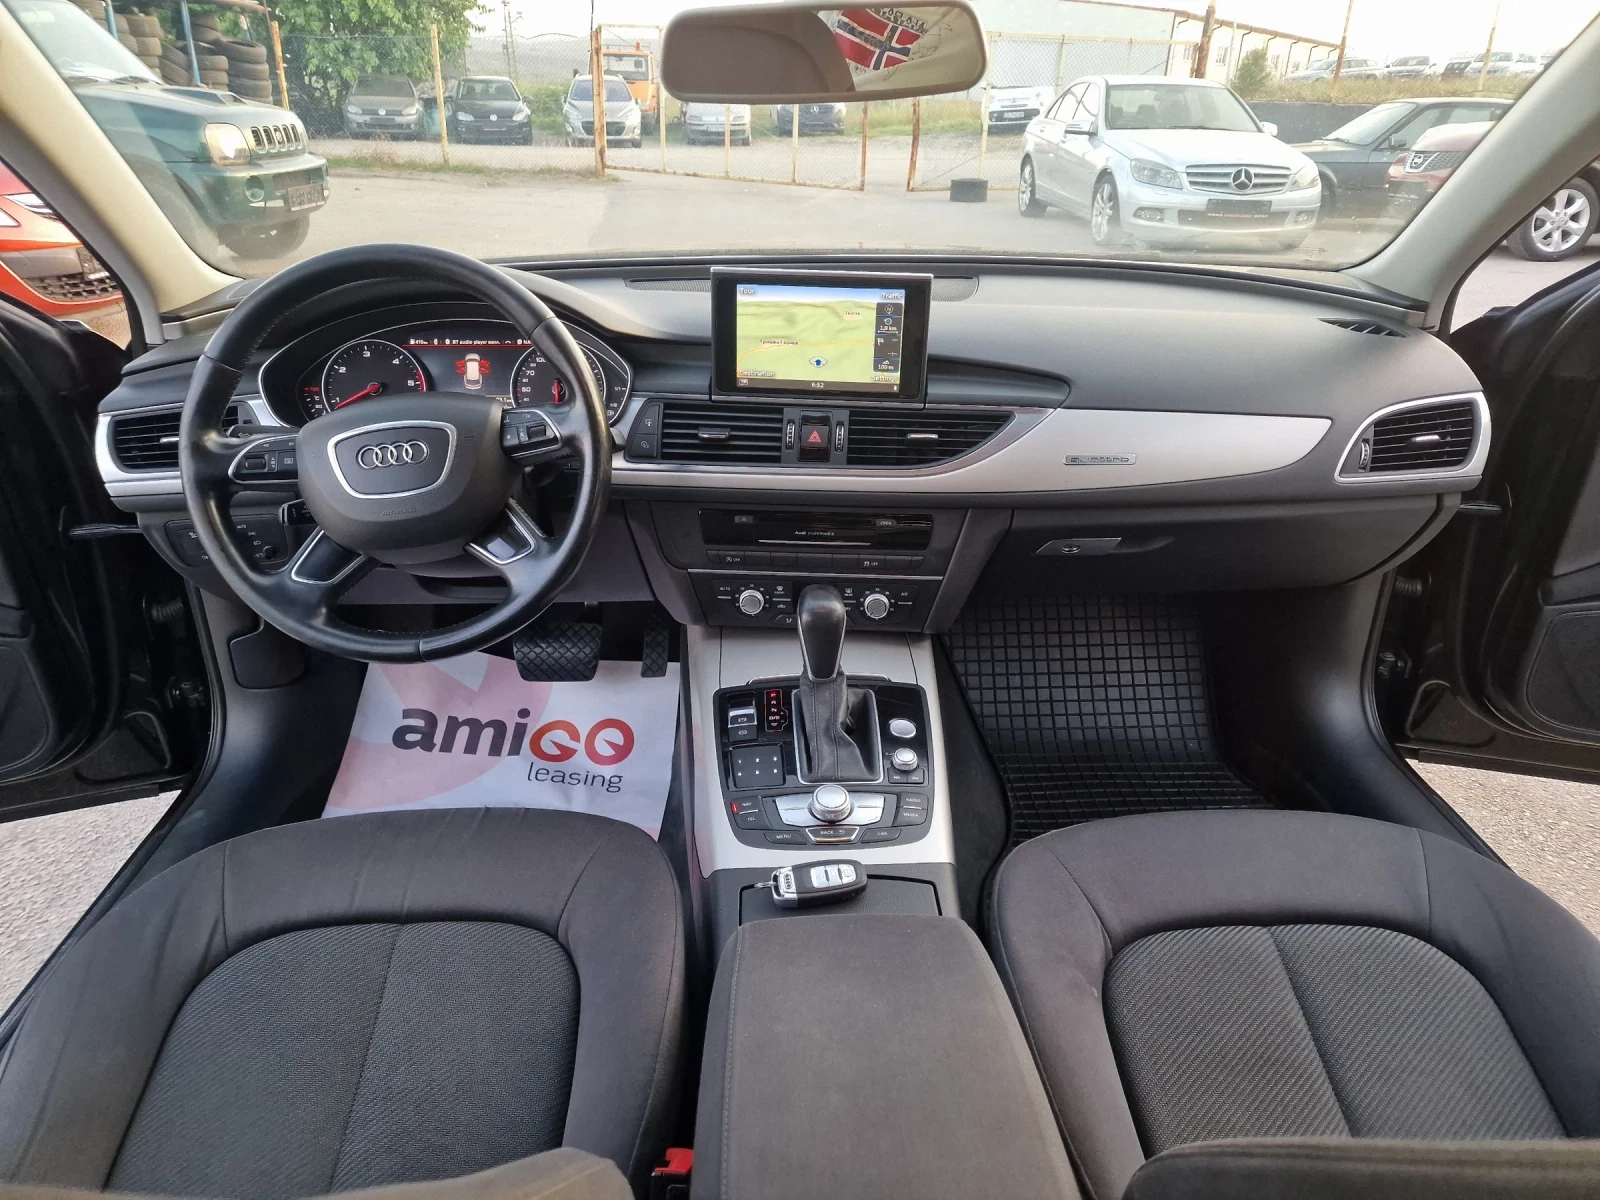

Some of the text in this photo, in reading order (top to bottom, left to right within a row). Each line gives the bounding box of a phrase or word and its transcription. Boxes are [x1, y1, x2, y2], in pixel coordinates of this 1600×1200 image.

[881, 292, 903, 300] Traffic
[739, 369, 775, 377] Destination
[871, 375, 897, 383] Settings
[1069, 455, 1130, 464] quattro
[527, 761, 624, 793] leasing
